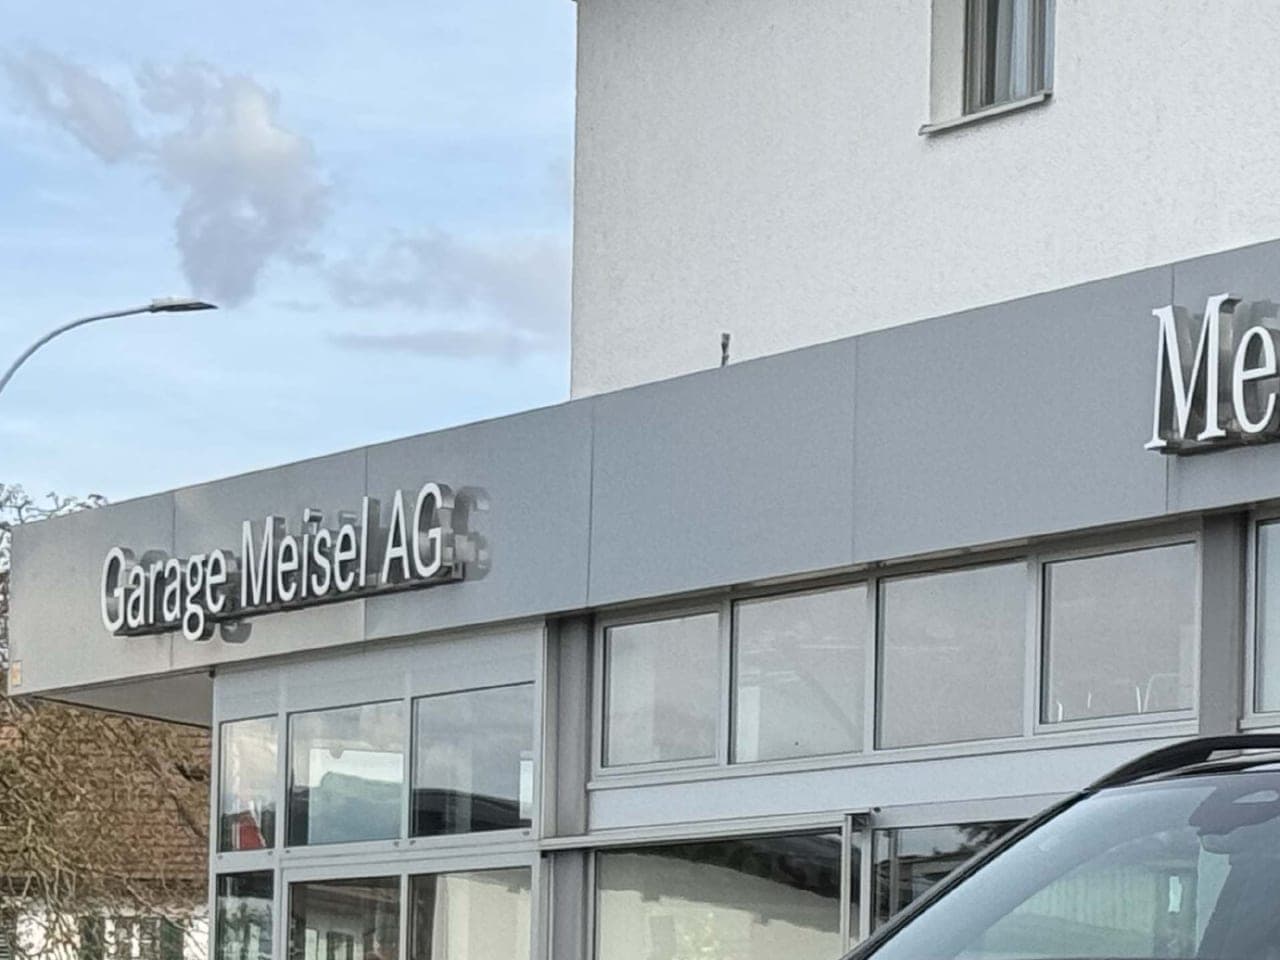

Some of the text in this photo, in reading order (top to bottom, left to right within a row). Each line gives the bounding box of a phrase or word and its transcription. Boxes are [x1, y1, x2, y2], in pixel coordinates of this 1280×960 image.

[100, 482, 444, 641] Garage Meisel AG
